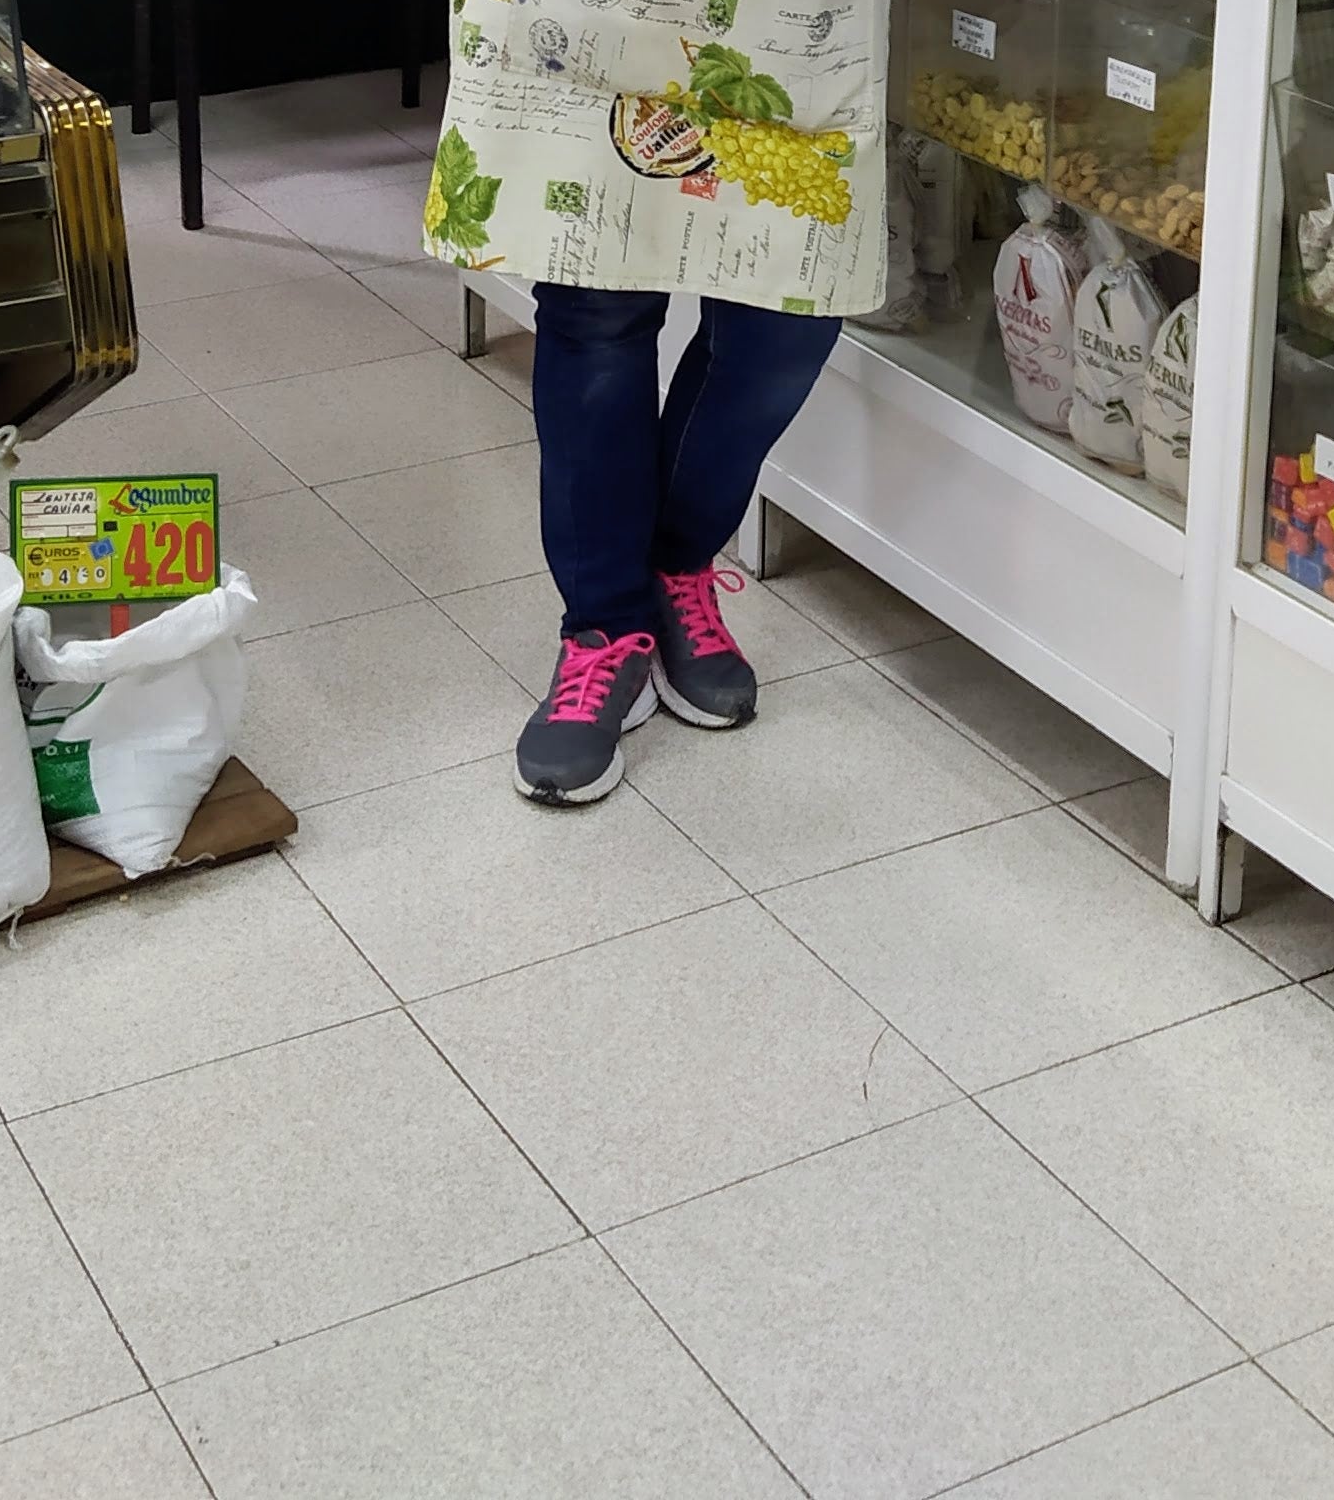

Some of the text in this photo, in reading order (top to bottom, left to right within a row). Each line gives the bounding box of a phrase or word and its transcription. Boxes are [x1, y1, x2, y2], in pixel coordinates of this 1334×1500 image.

[778, 9, 813, 22] CARTE
[677, 210, 696, 285] CARTE POSTALE
[798, 215, 819, 282] CARTE POSTALE
[33, 489, 94, 504] LENTEJA
[108, 482, 212, 515] Legumbre
[43, 502, 92, 515] CAVIAR
[42, 591, 94, 601] KILO
